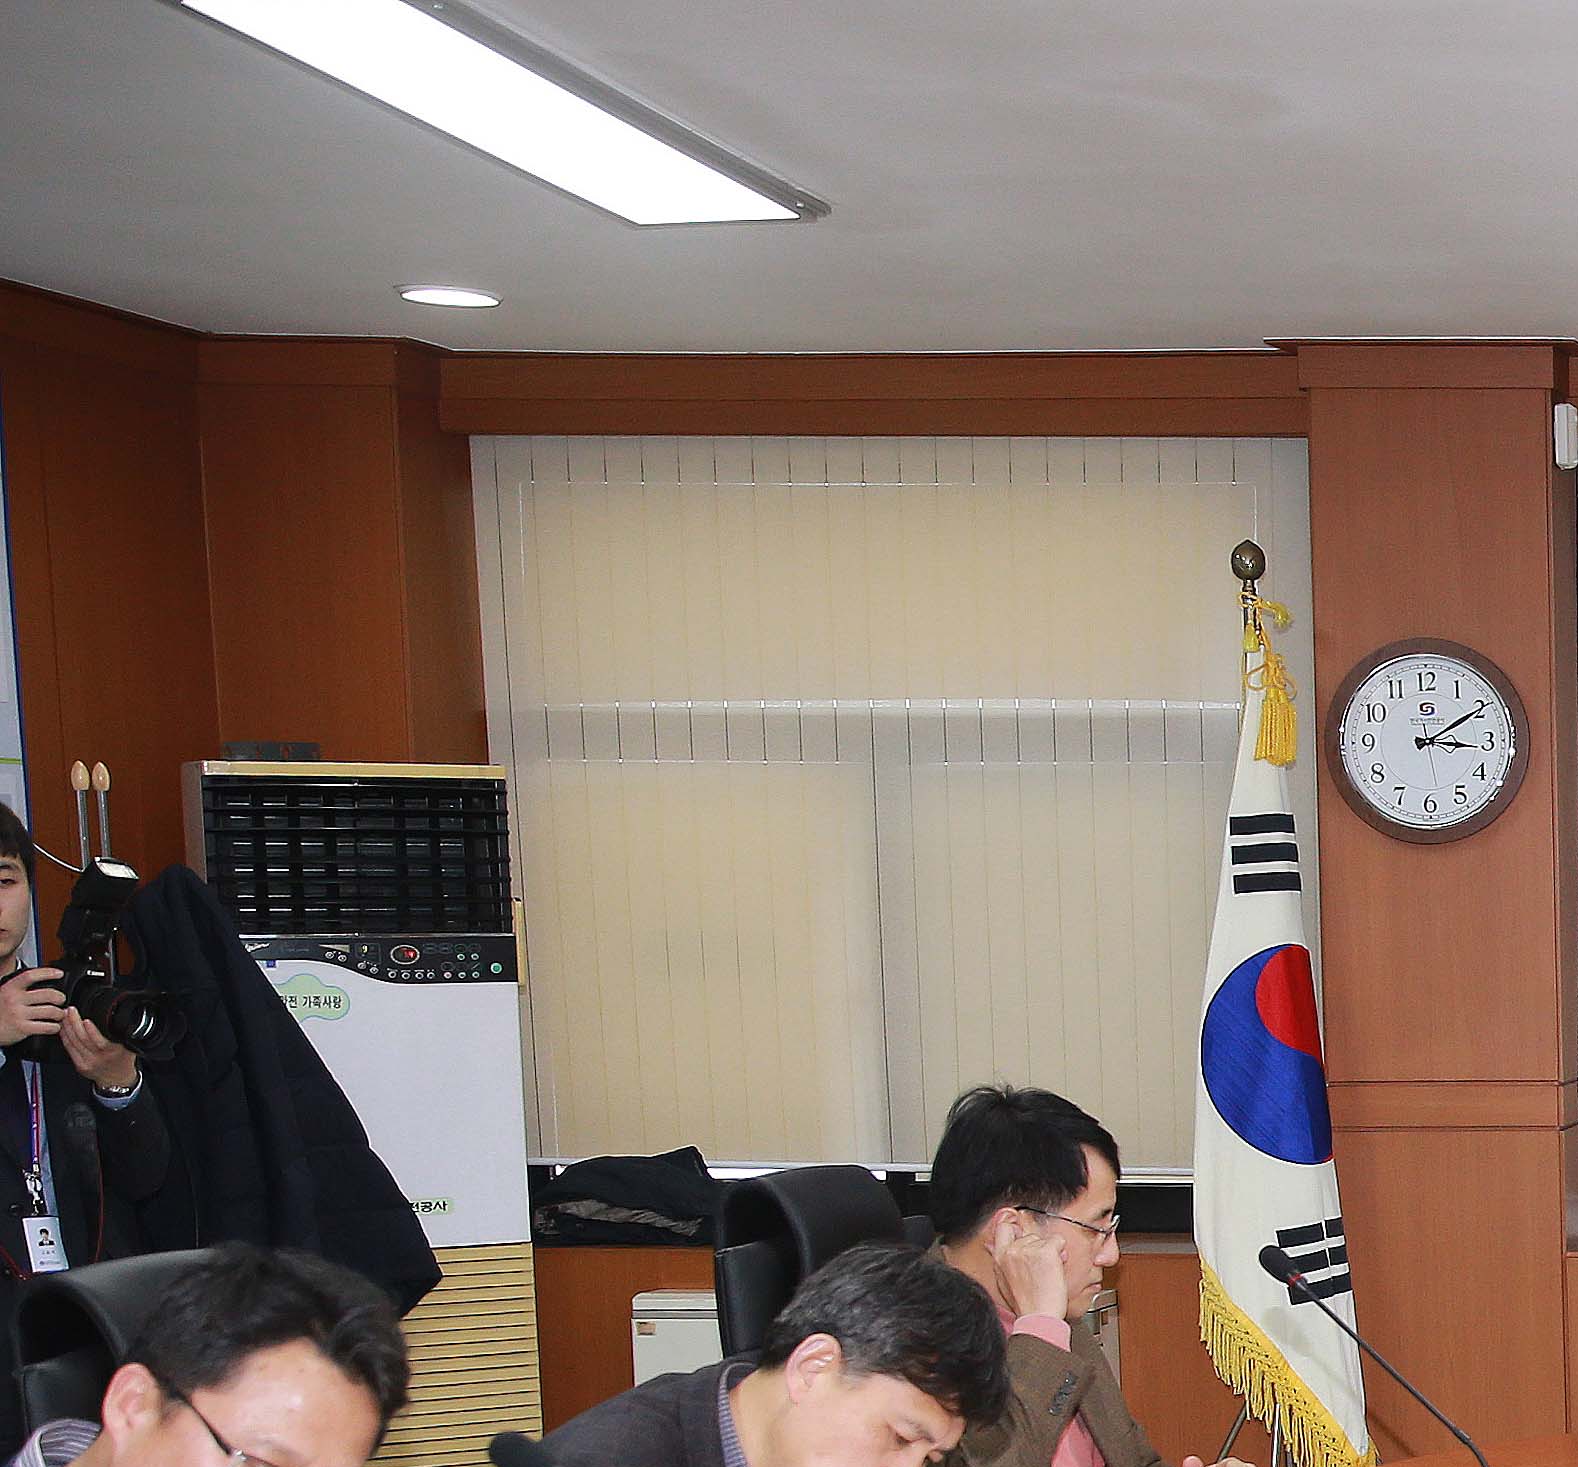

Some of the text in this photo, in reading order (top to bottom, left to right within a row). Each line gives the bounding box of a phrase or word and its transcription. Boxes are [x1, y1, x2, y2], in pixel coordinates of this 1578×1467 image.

[1388, 679, 1405, 699] 11
[1416, 671, 1437, 692] 12
[1453, 679, 1461, 699] 1
[1365, 703, 1387, 723] 10
[1472, 699, 1487, 719] 2
[1361, 733, 1375, 752] 9
[1481, 732, 1495, 751] 3
[1370, 763, 1385, 784] 8
[1472, 762, 1487, 781] 4
[1393, 786, 1406, 806] 7
[1423, 793, 1437, 813] 6
[1452, 785, 1467, 805] 5
[303, 996, 342, 1009] 가족사랑
